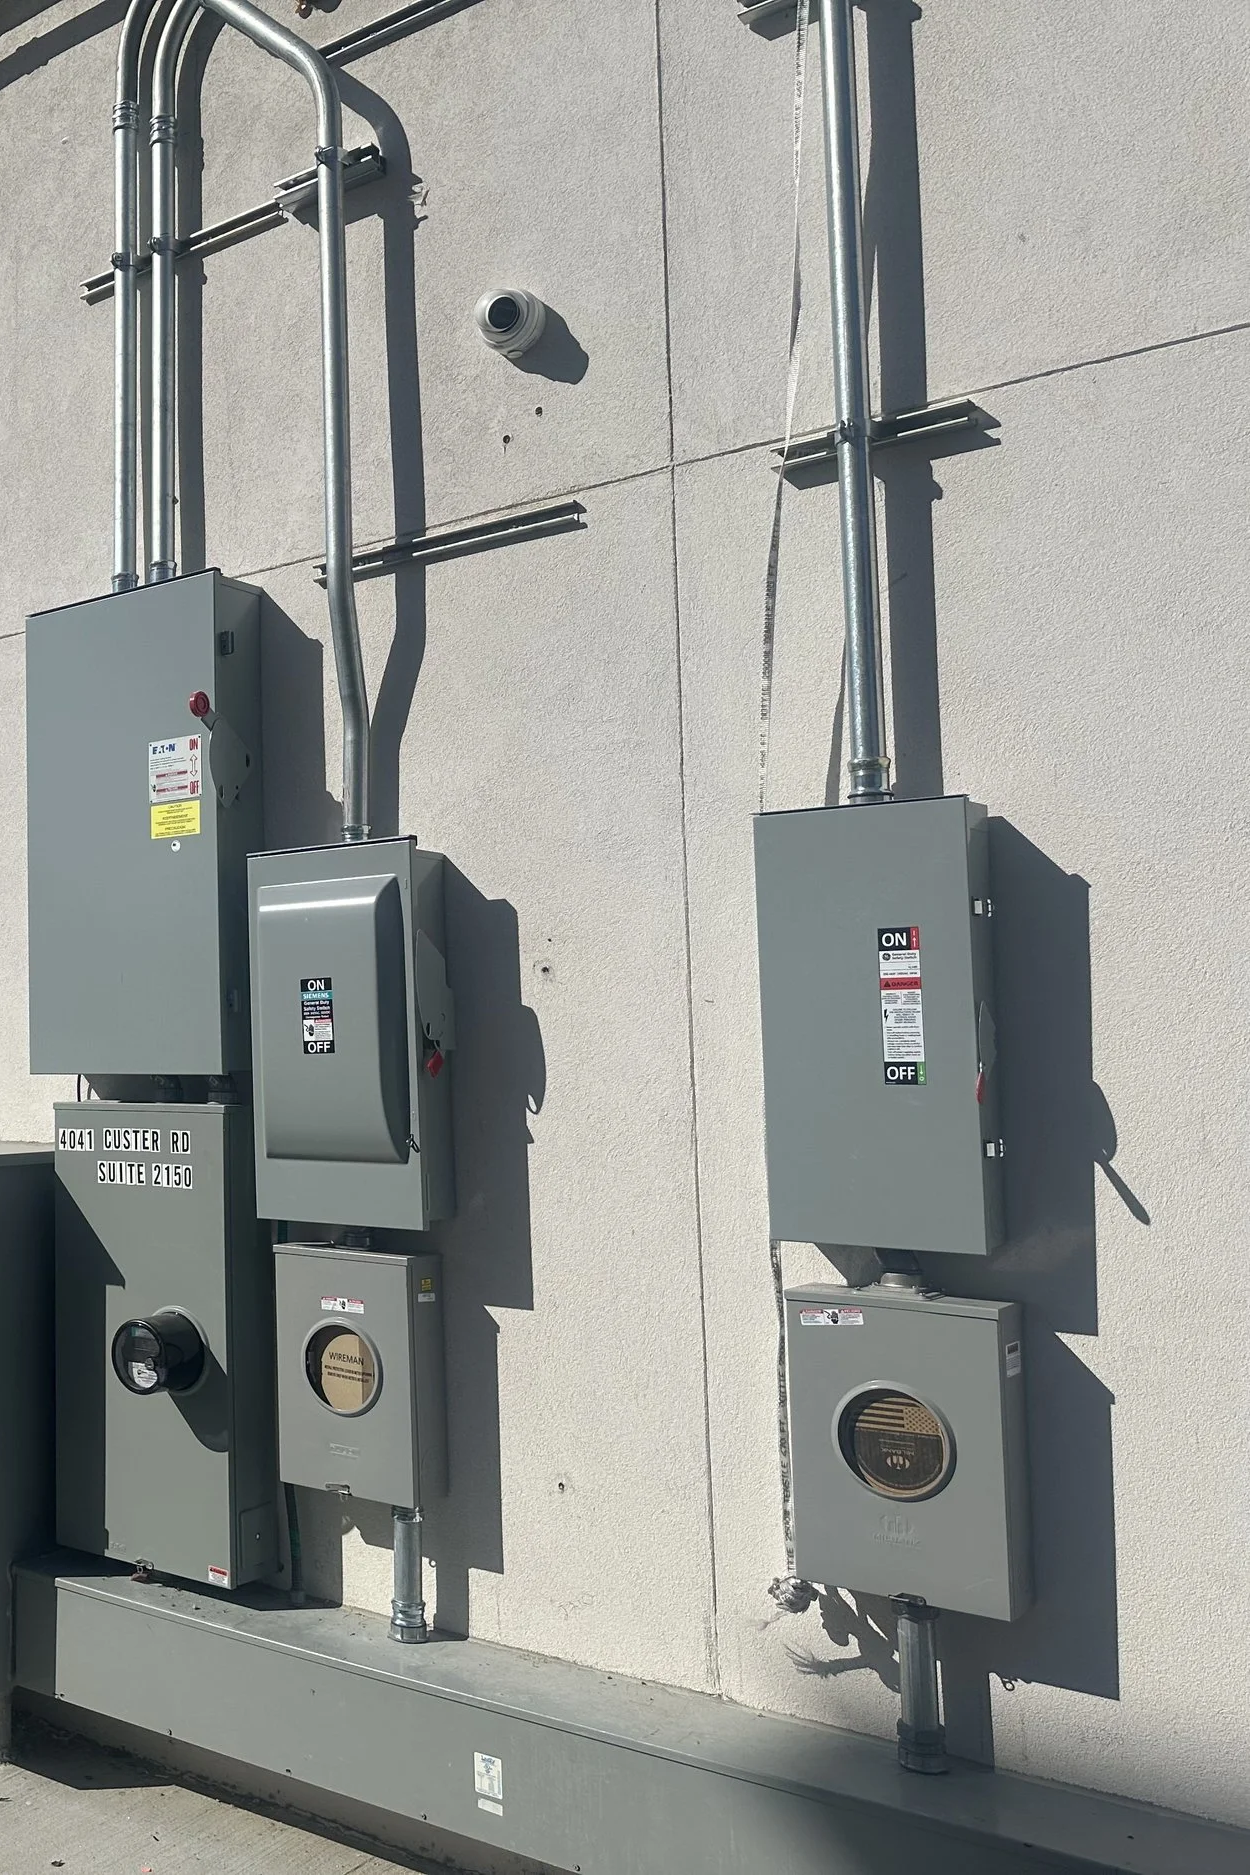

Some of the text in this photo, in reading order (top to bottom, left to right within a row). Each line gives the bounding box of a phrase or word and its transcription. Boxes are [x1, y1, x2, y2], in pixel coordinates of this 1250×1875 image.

[189, 738, 199, 751] ON
[189, 780, 200, 795] OFF
[881, 932, 907, 947] ON
[307, 979, 325, 991] ON
[307, 1041, 331, 1053] OFF
[886, 1066, 916, 1081] OFF
[60, 1129, 190, 1153] 4041 CUSTER RD
[98, 1162, 192, 1187] SUITE 2150
[328, 1351, 364, 1366] WIREMAN
